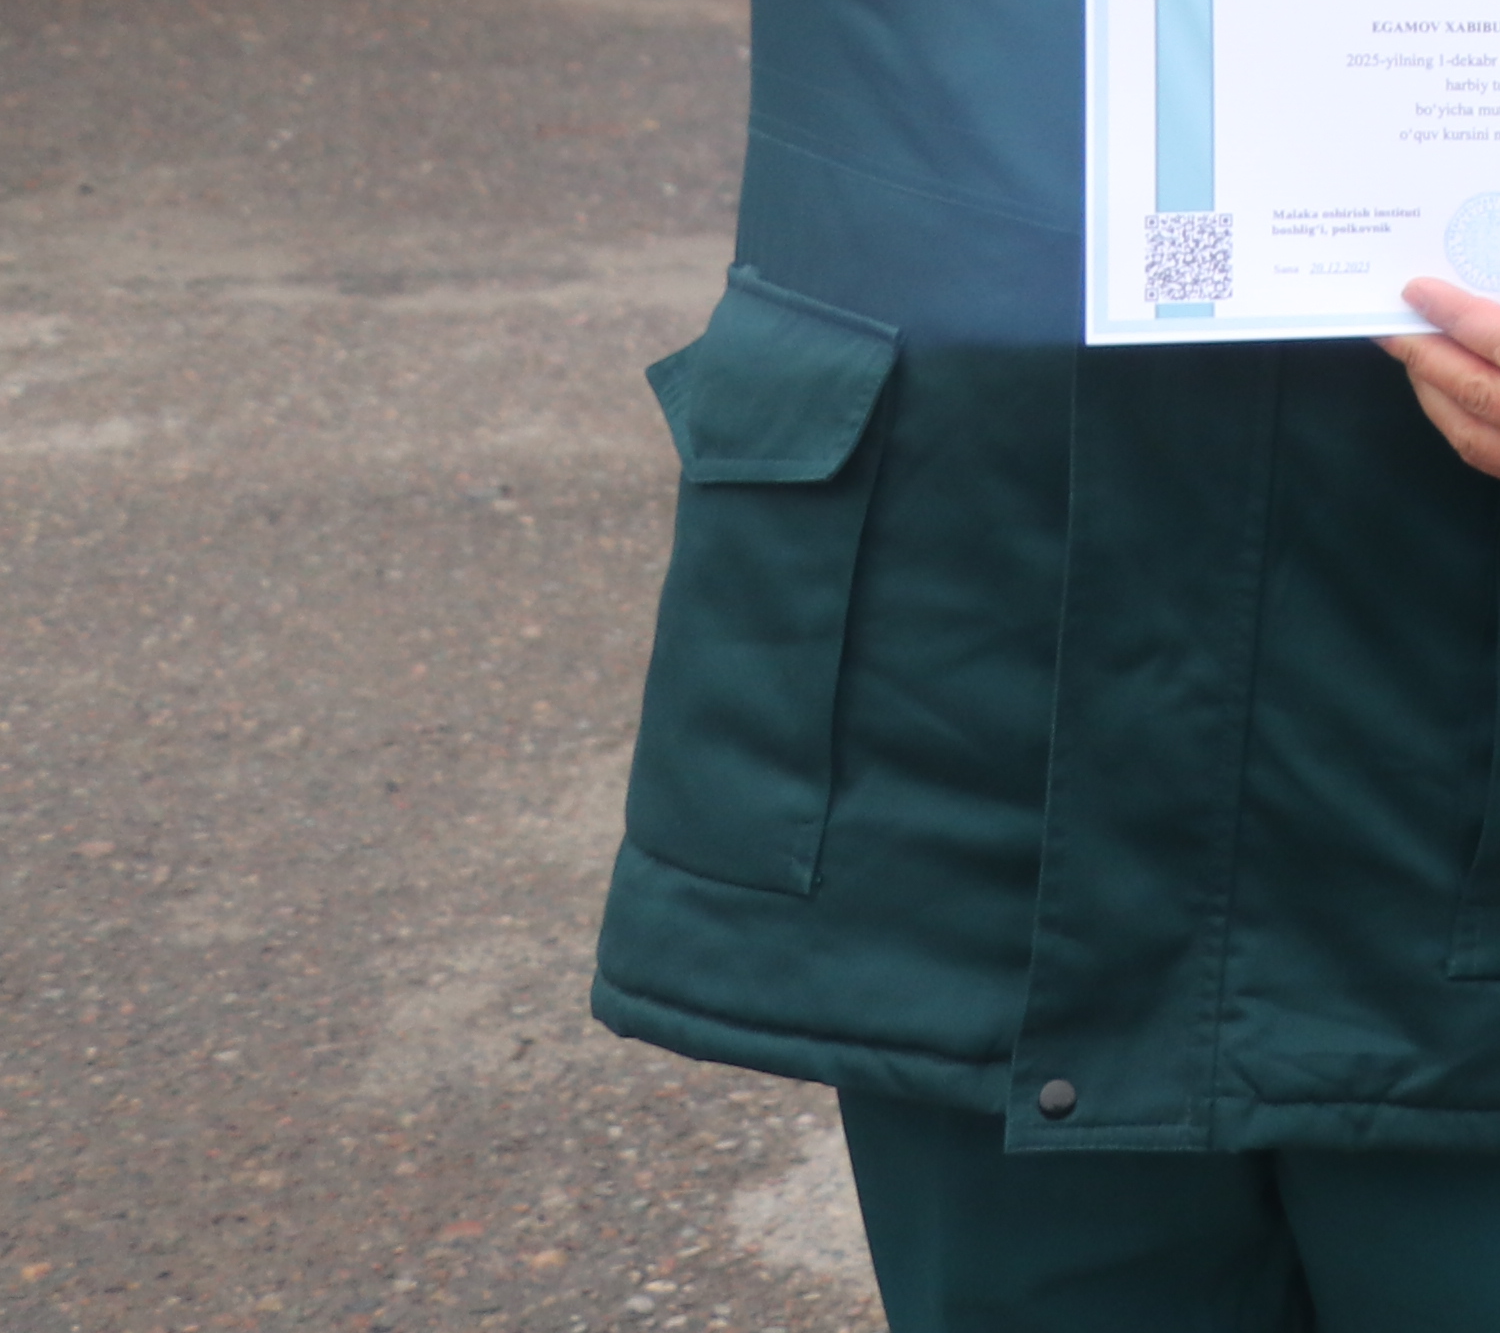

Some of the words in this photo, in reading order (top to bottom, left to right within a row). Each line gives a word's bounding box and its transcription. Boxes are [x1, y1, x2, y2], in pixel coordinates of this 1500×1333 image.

[1346, 52, 1434, 72] 2025-yilning
[1440, 53, 1498, 68] 1-dekabr
[1445, 78, 1488, 96] harbiy
[1443, 127, 1489, 142] kursini
[1273, 209, 1318, 221] Malaka
[1322, 208, 1370, 220] oshirish
[1332, 222, 1391, 237] polkovnik
